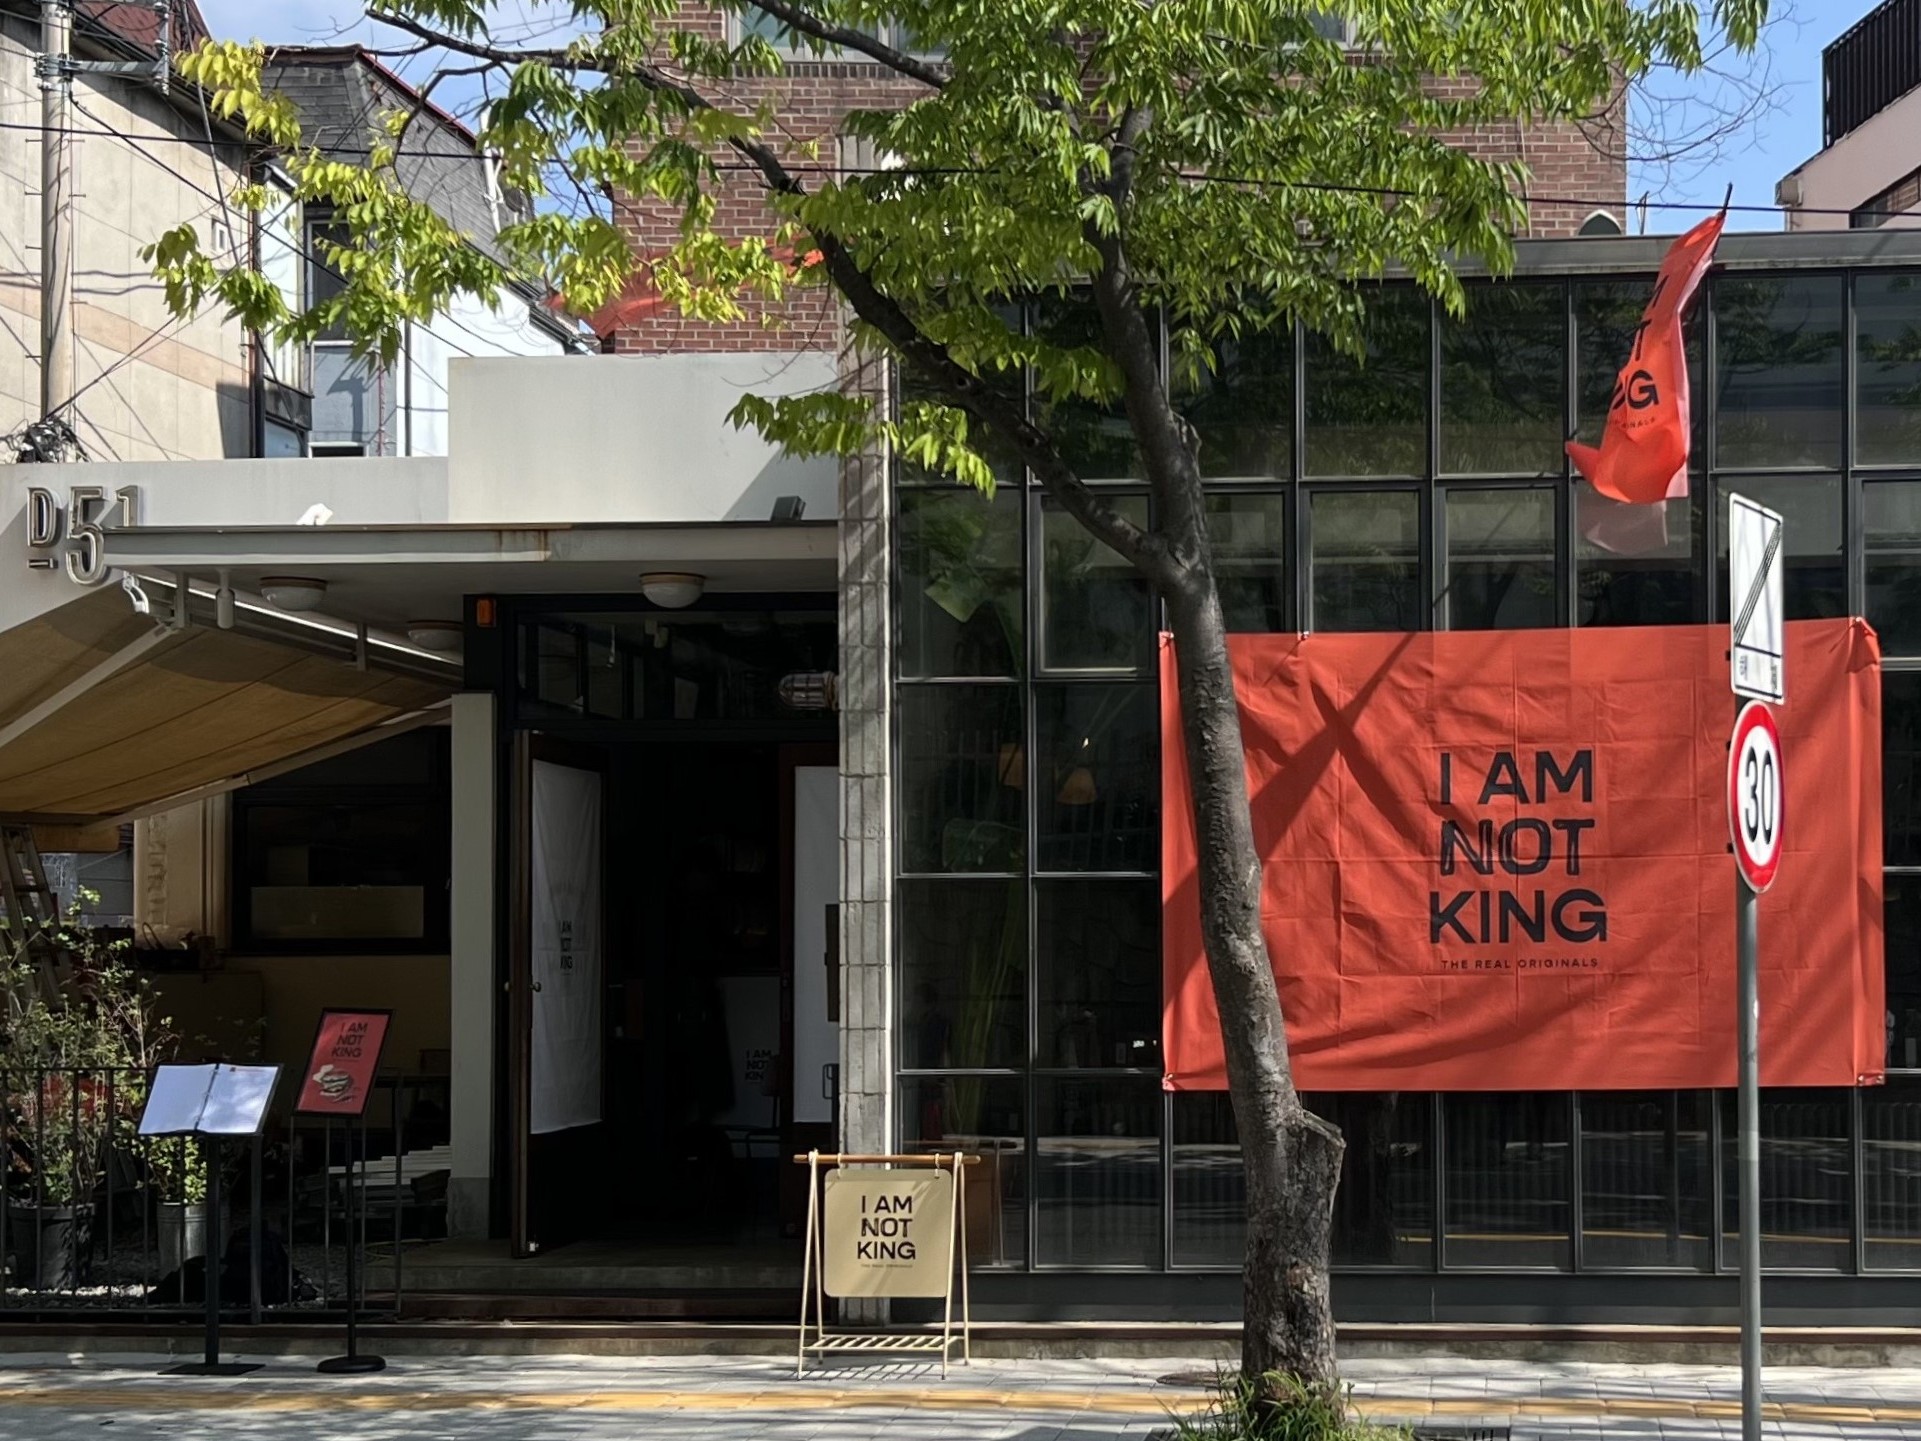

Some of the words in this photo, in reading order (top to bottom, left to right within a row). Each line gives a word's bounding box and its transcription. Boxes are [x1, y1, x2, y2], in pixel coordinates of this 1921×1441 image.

[1440, 752, 1451, 805] I
[1477, 749, 1593, 804] AM
[1745, 746, 1774, 845] 30
[1441, 818, 1595, 876] NOT
[1430, 888, 1607, 944] KING
[1441, 960, 1468, 969] THE
[1475, 960, 1511, 968] REAL
[1518, 958, 1598, 967] ORIGINALS
[341, 1022, 346, 1032] I
[347, 1022, 368, 1032] AM
[336, 1035, 365, 1045] NOT
[331, 1047, 362, 1057] KING
[752, 1049, 771, 1058] AM
[745, 1072, 766, 1080] KIN
[862, 1195, 866, 1213] I
[874, 1195, 912, 1213] AM
[861, 1217, 913, 1238] NOT
[857, 1241, 916, 1260] KING
